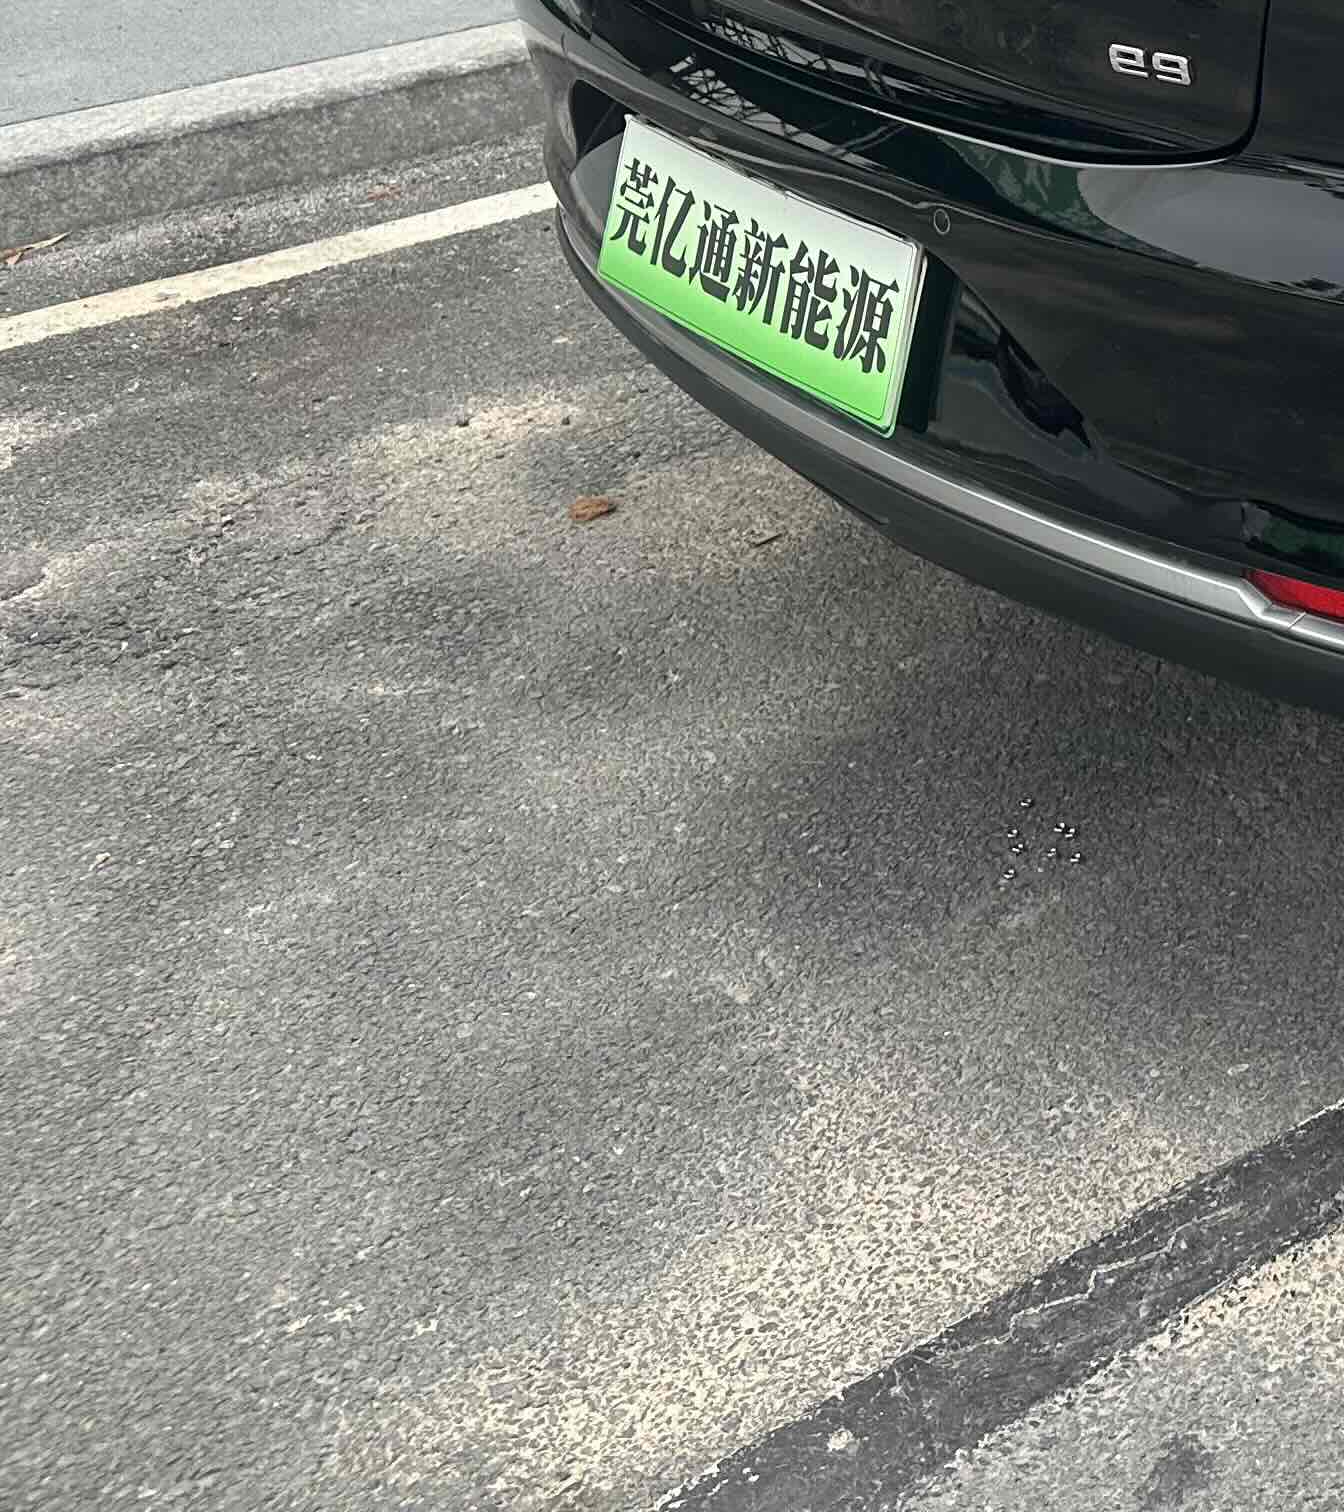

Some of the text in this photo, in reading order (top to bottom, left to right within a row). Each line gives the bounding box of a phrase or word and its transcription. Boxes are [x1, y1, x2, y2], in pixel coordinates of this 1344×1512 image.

[610, 156, 901, 375] 莞亿通新能源
